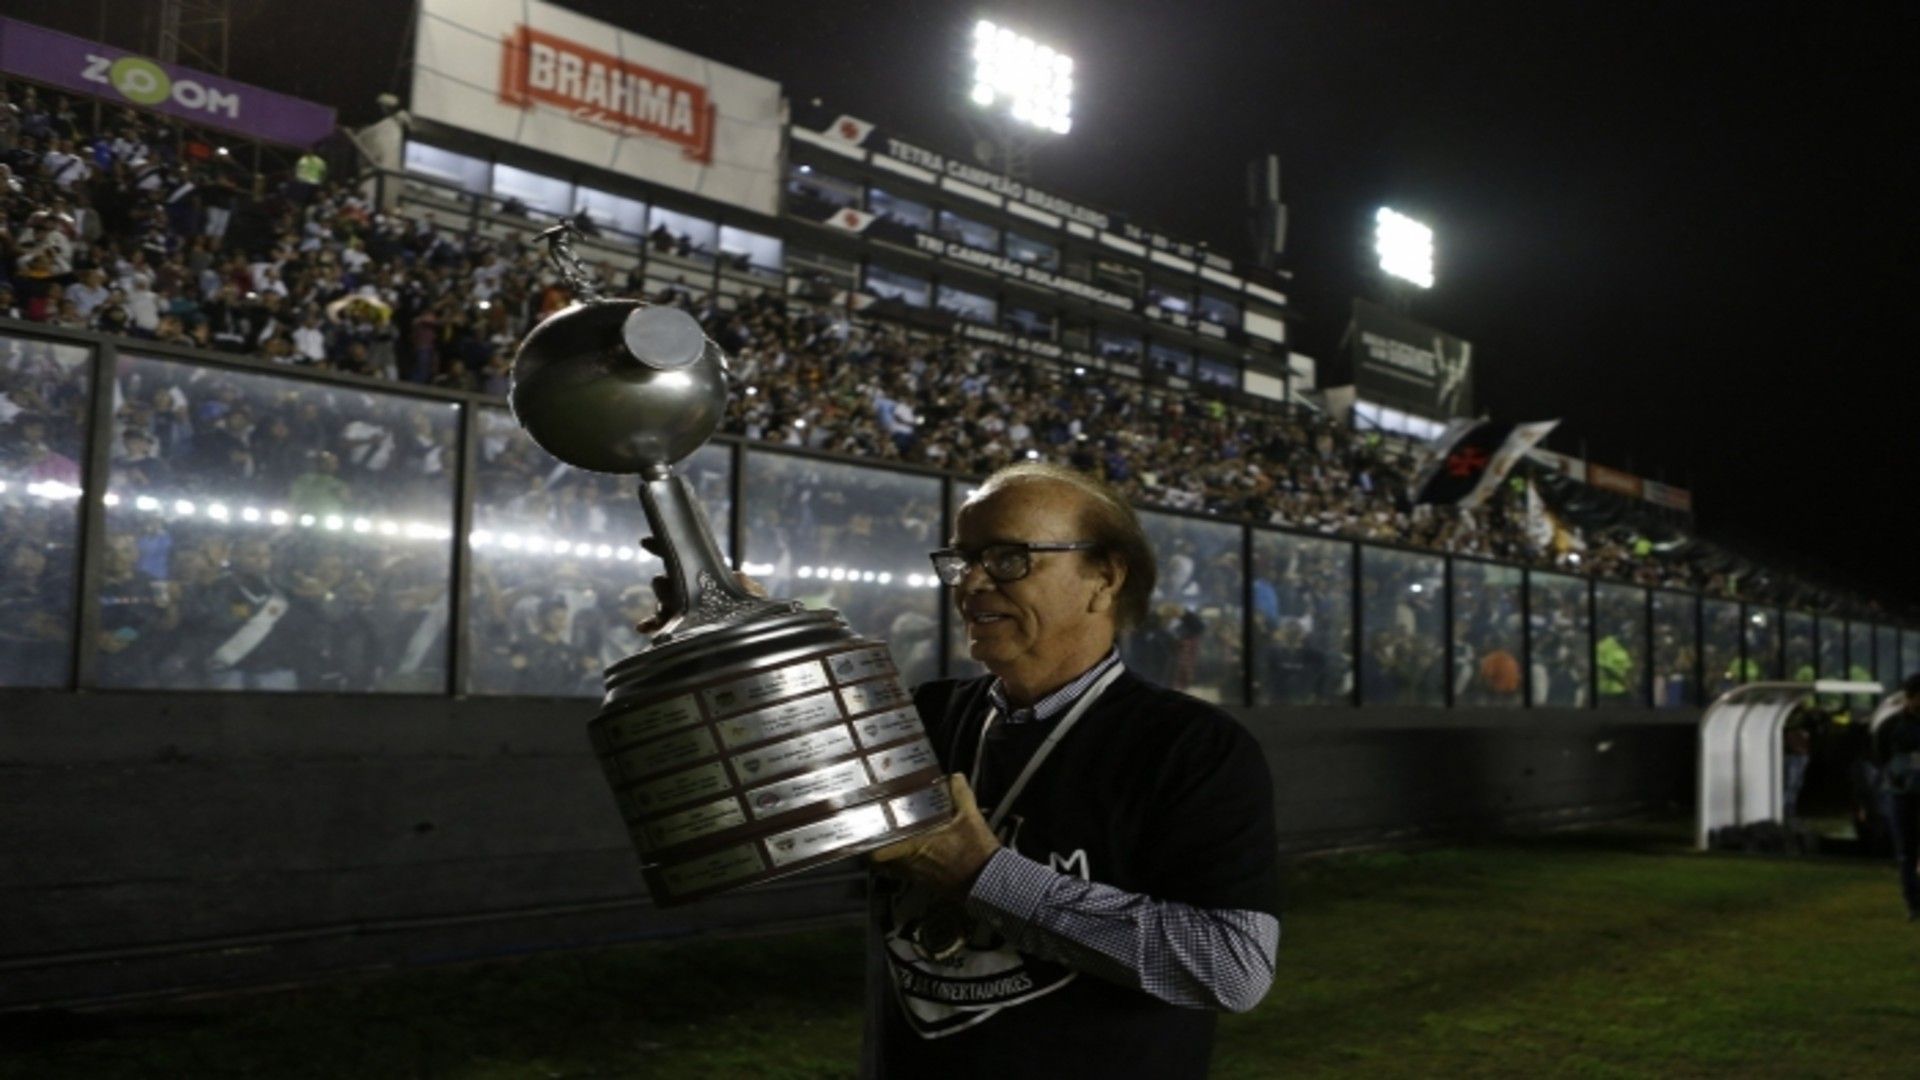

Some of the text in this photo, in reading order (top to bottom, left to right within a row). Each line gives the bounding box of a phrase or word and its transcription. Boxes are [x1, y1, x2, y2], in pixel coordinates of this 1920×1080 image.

[81, 54, 241, 119] ZOOM
[528, 42, 694, 136] BRAHMA
[888, 138, 945, 172] TETRA
[915, 232, 945, 253] TRI
